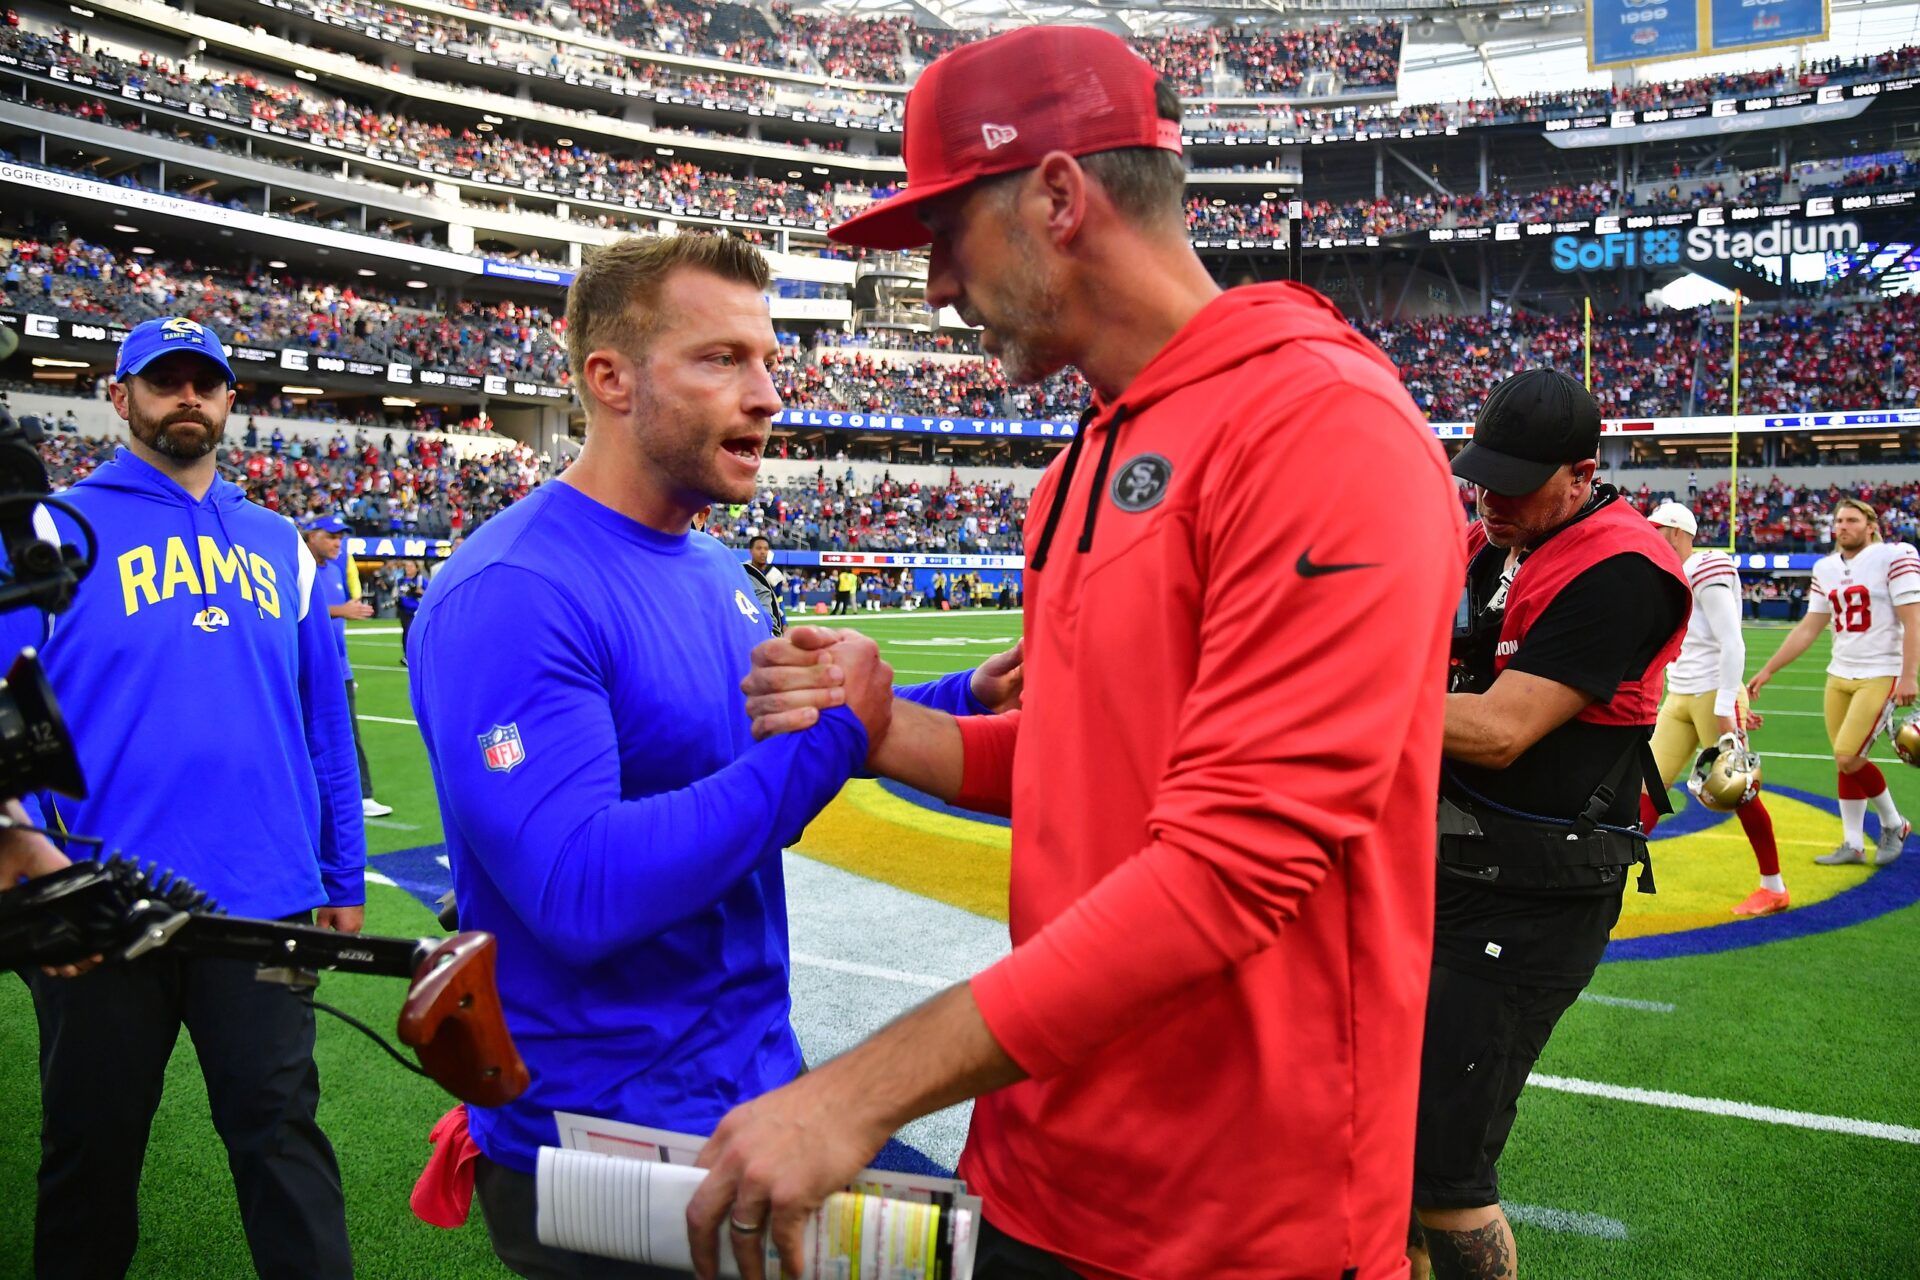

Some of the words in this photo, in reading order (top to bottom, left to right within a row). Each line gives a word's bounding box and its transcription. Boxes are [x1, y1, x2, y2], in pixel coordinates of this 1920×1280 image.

[1620, 7, 1668, 24] 1999
[1553, 232, 1635, 270] SoFi
[1687, 219, 1859, 261] Stadium
[922, 418, 954, 432] TO
[972, 420, 1023, 434] THE
[346, 537, 452, 557] RAMS
[117, 535, 281, 619] RAMS
[1828, 584, 1872, 633] 18
[1495, 639, 1519, 657] ION
[486, 741, 520, 768] NFL
